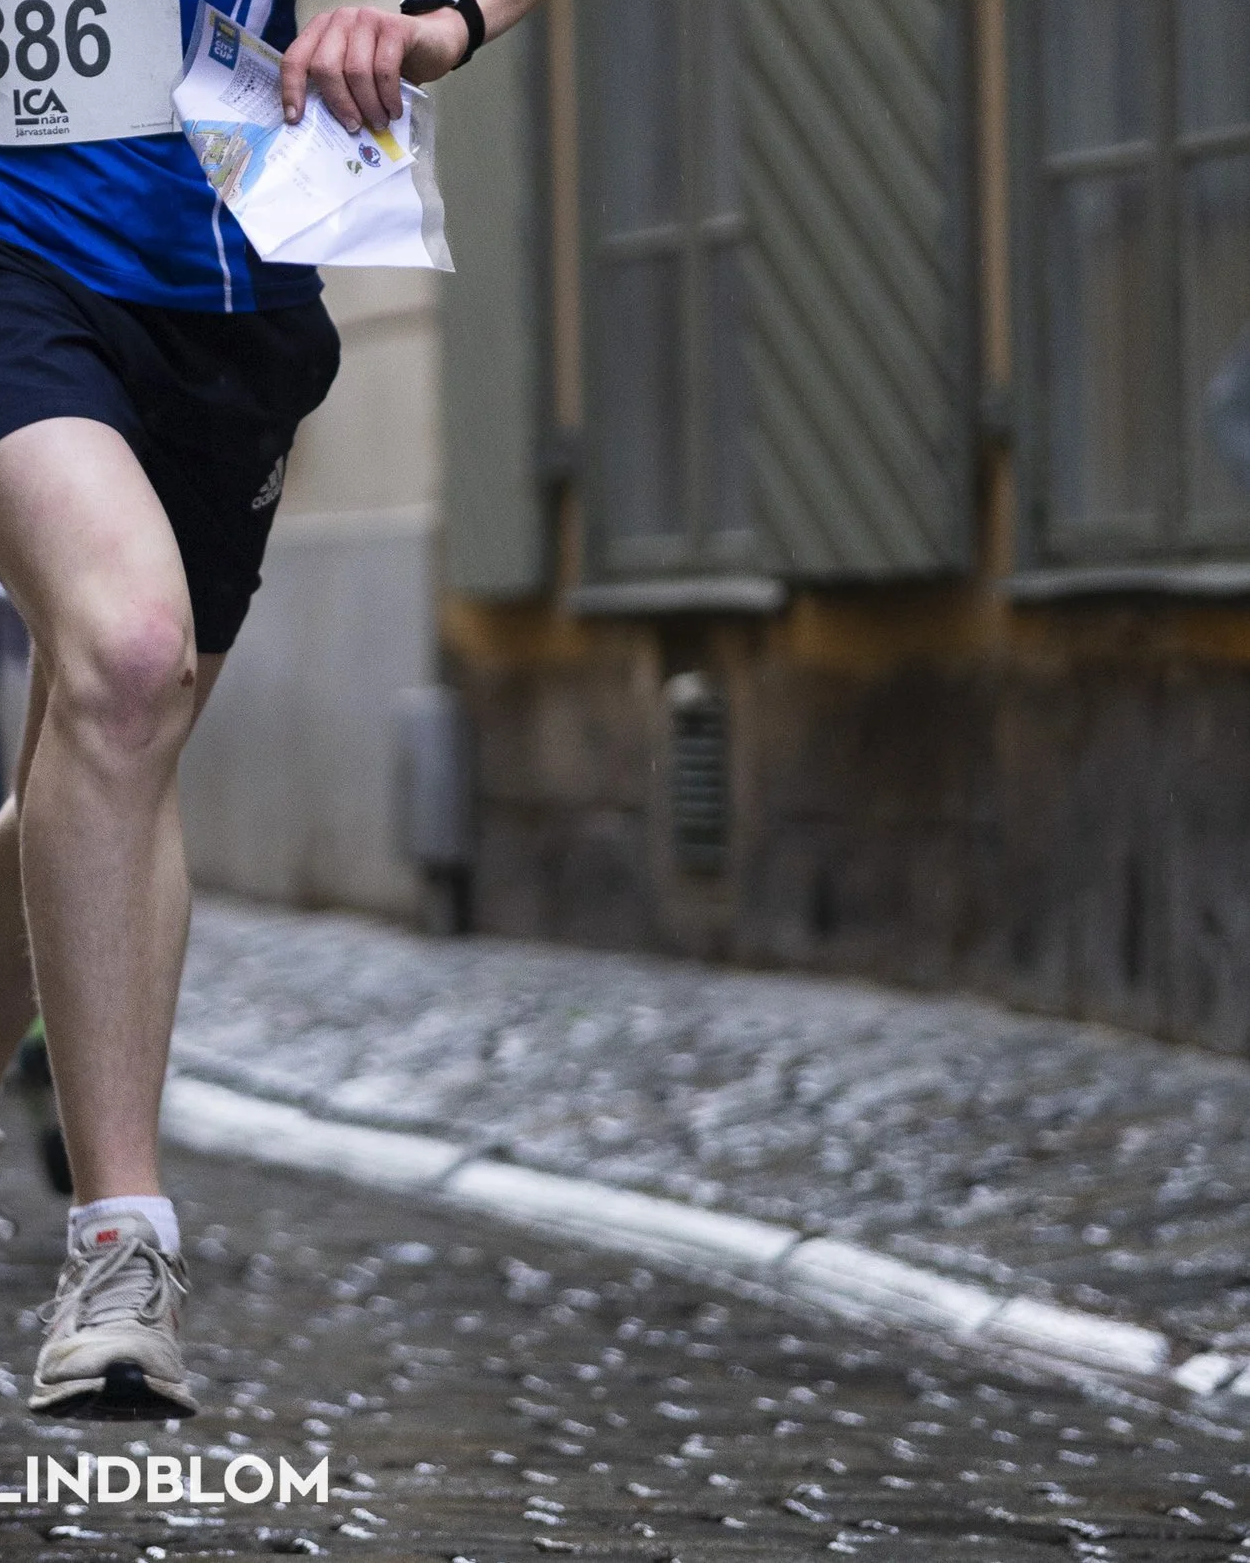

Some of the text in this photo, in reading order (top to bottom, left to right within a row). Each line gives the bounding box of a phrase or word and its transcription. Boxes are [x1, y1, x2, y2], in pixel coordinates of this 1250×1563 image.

[215, 40, 235, 52] CITY
[214, 46, 233, 60] CUP
[13, 87, 68, 116] ICA
[41, 113, 70, 125] nära
